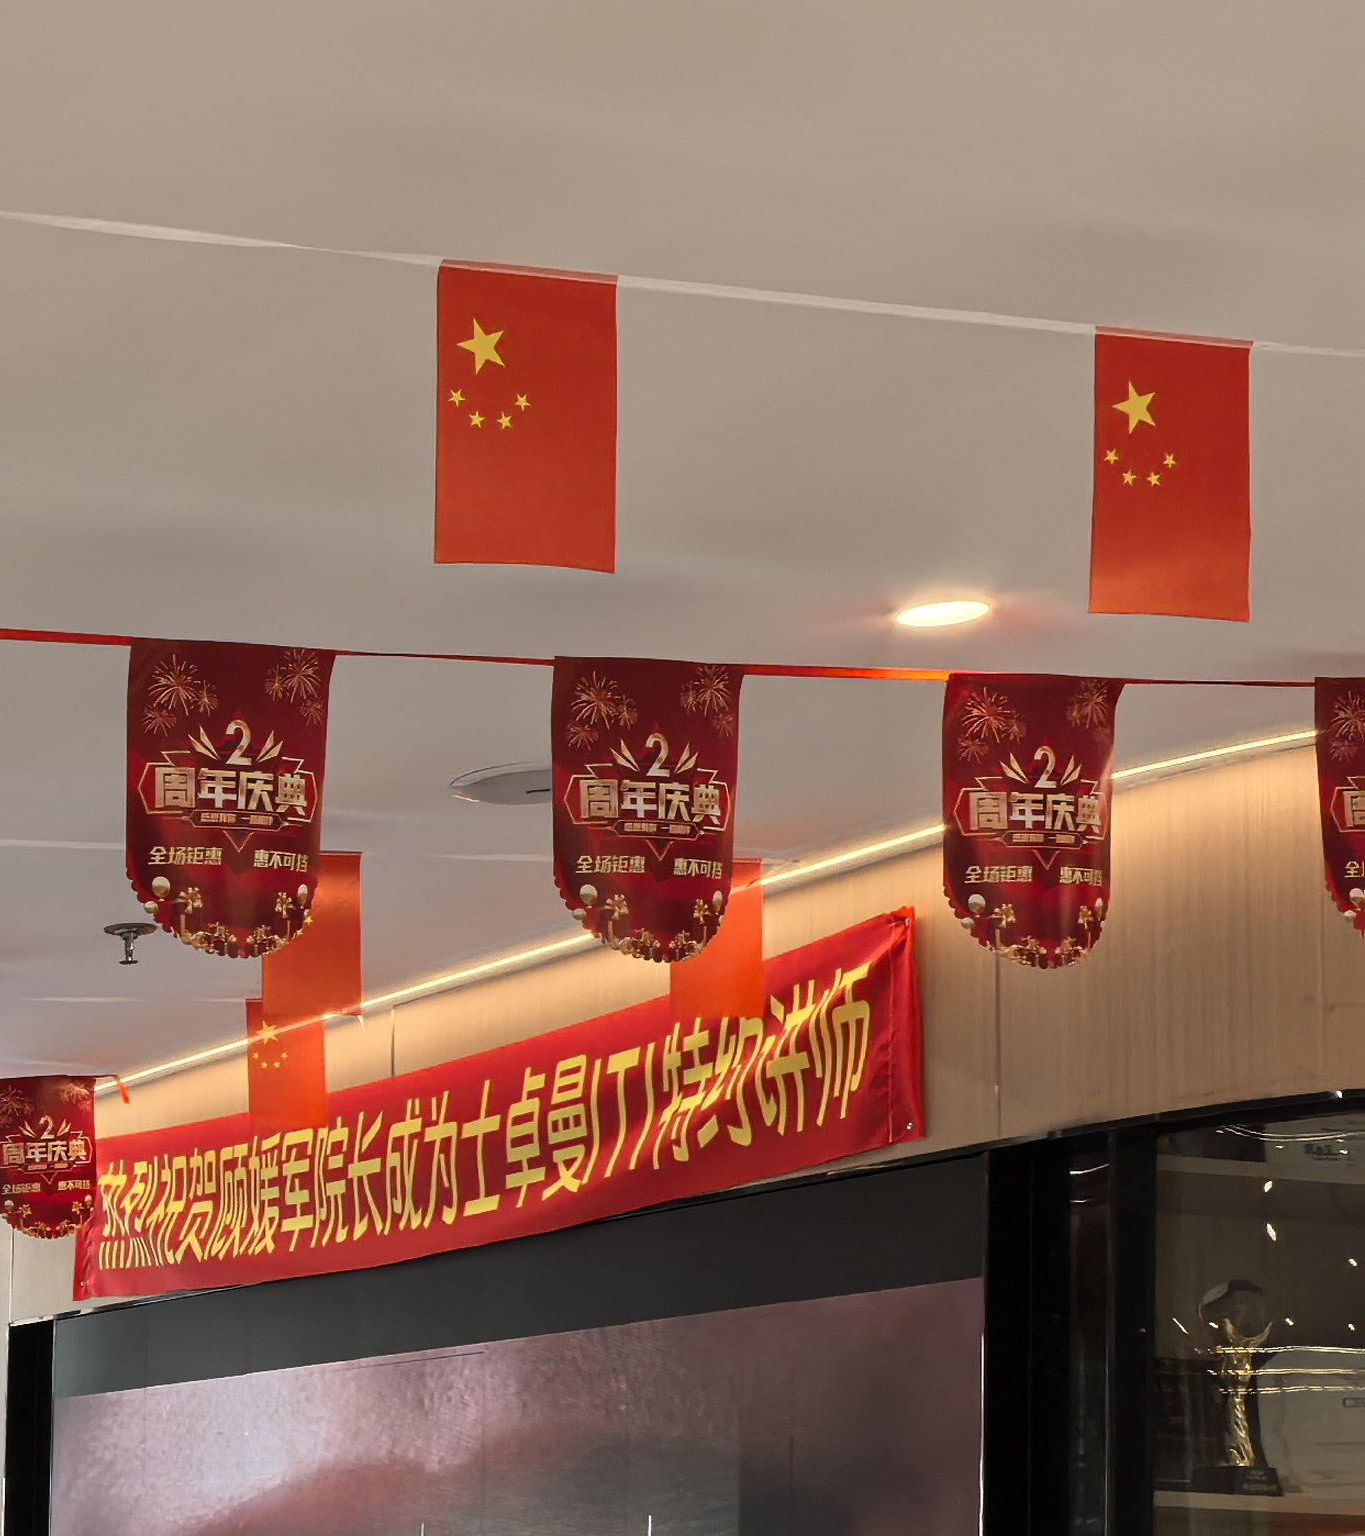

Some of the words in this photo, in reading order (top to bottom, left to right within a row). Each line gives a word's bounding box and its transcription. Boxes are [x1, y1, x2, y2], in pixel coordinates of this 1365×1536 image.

[225, 719, 252, 766] 2
[645, 732, 670, 777] 2
[1033, 745, 1057, 788] 2
[154, 766, 308, 816] 周年庆典
[579, 779, 722, 825] 周年庆典
[969, 791, 1102, 832] 周年庆典
[39, 1115, 55, 1140] 2
[2, 1139, 87, 1165] 周年庆典
